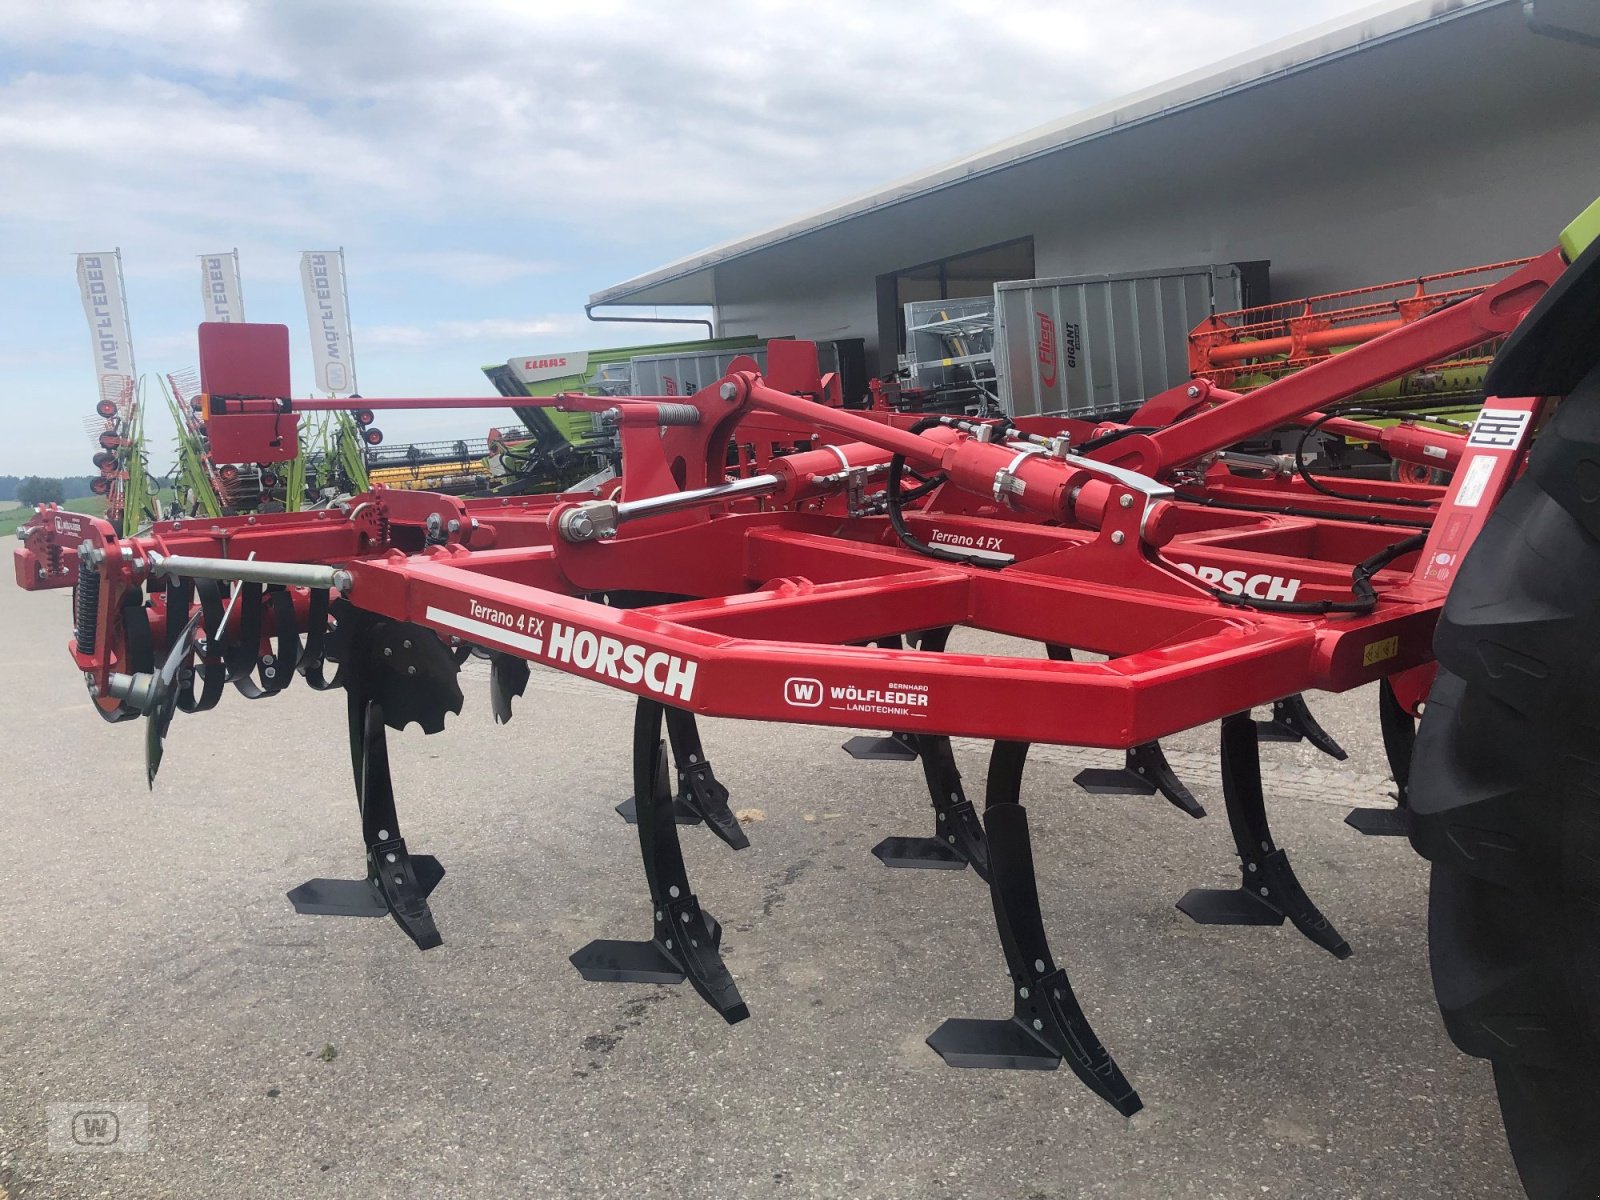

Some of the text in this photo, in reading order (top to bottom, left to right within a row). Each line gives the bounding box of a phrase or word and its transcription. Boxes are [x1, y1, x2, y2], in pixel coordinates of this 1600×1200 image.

[1065, 322, 1076, 368] GIGANT
[525, 358, 567, 369] CLAAS
[1470, 412, 1525, 446] EAC
[932, 529, 1003, 550] Terrano 4 FX
[470, 599, 544, 637] Terrano 4 FX
[548, 623, 698, 701] HORSCH
[794, 684, 814, 700] W
[830, 686, 928, 706] WÖLFLEDER
[889, 683, 928, 692] BERNHARD
[847, 704, 909, 715] LANDTECHNIK
